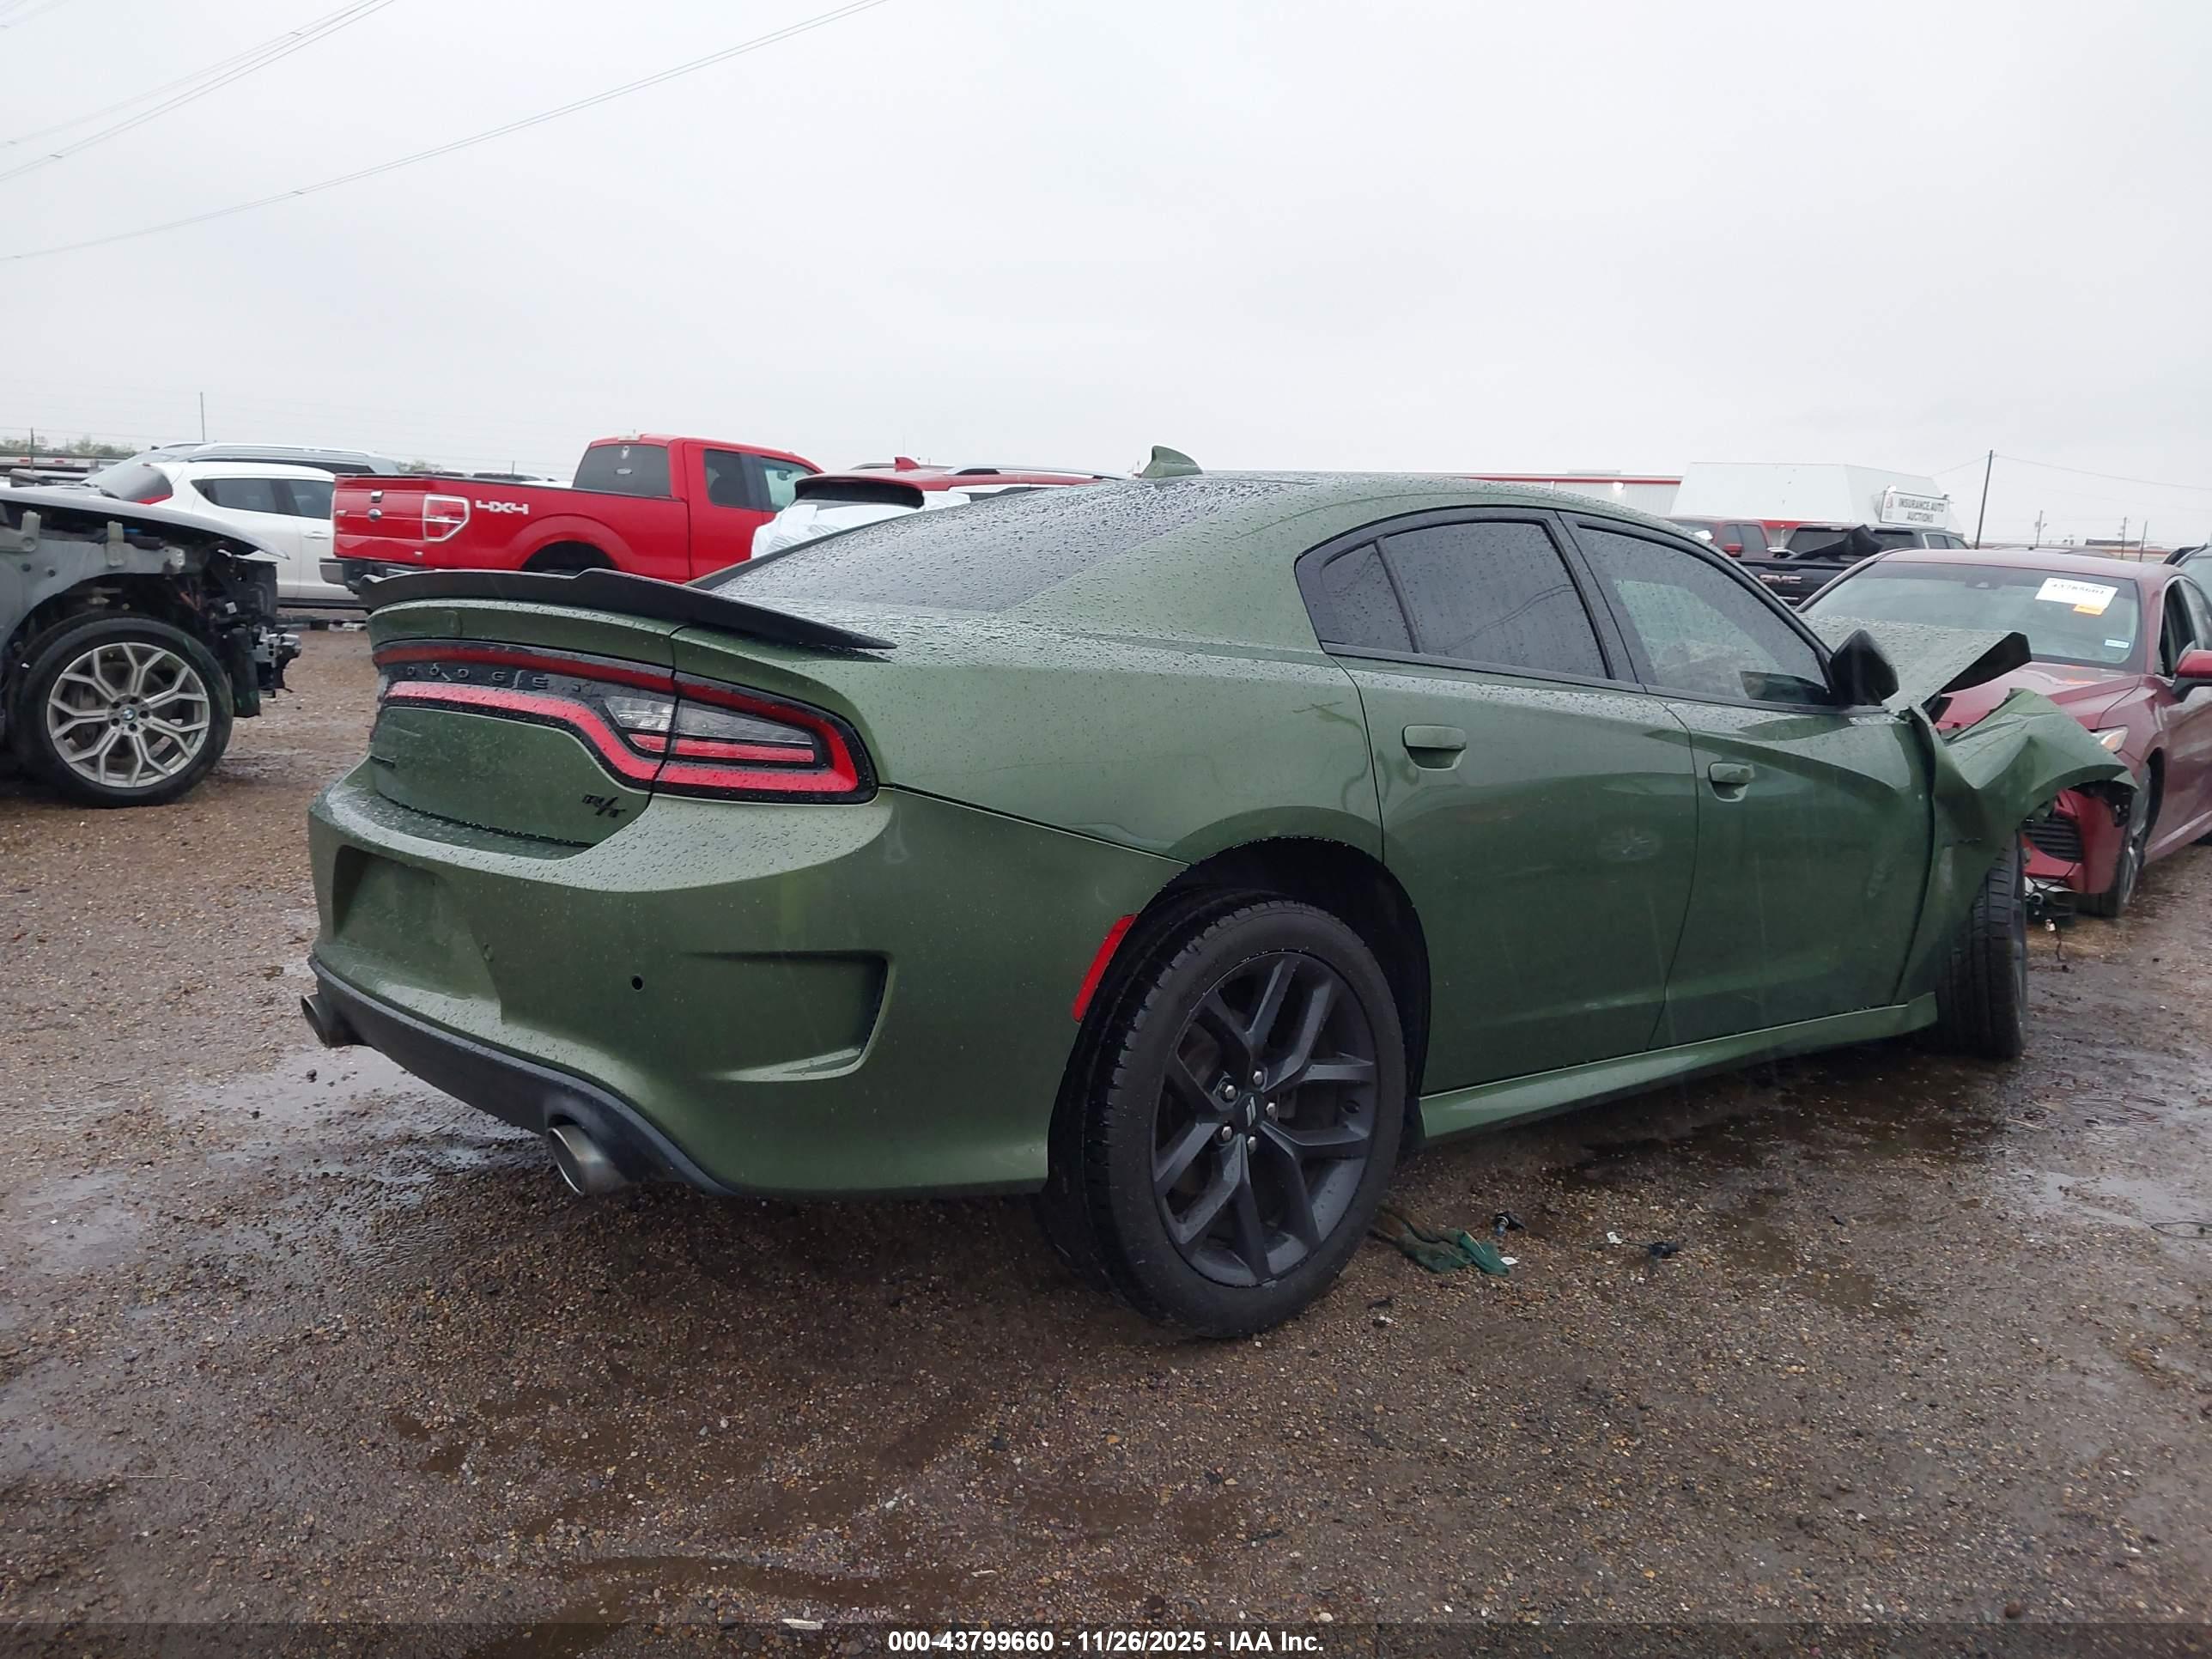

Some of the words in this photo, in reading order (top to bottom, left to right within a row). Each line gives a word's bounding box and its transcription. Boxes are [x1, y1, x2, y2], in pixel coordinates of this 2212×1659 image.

[1899, 498, 1930, 510] INSURANCE
[1931, 502, 1945, 512] AUTO
[1907, 512, 1934, 522] AUCTIONS
[1759, 574, 1802, 584] GMC
[407, 665, 550, 685] DODGE
